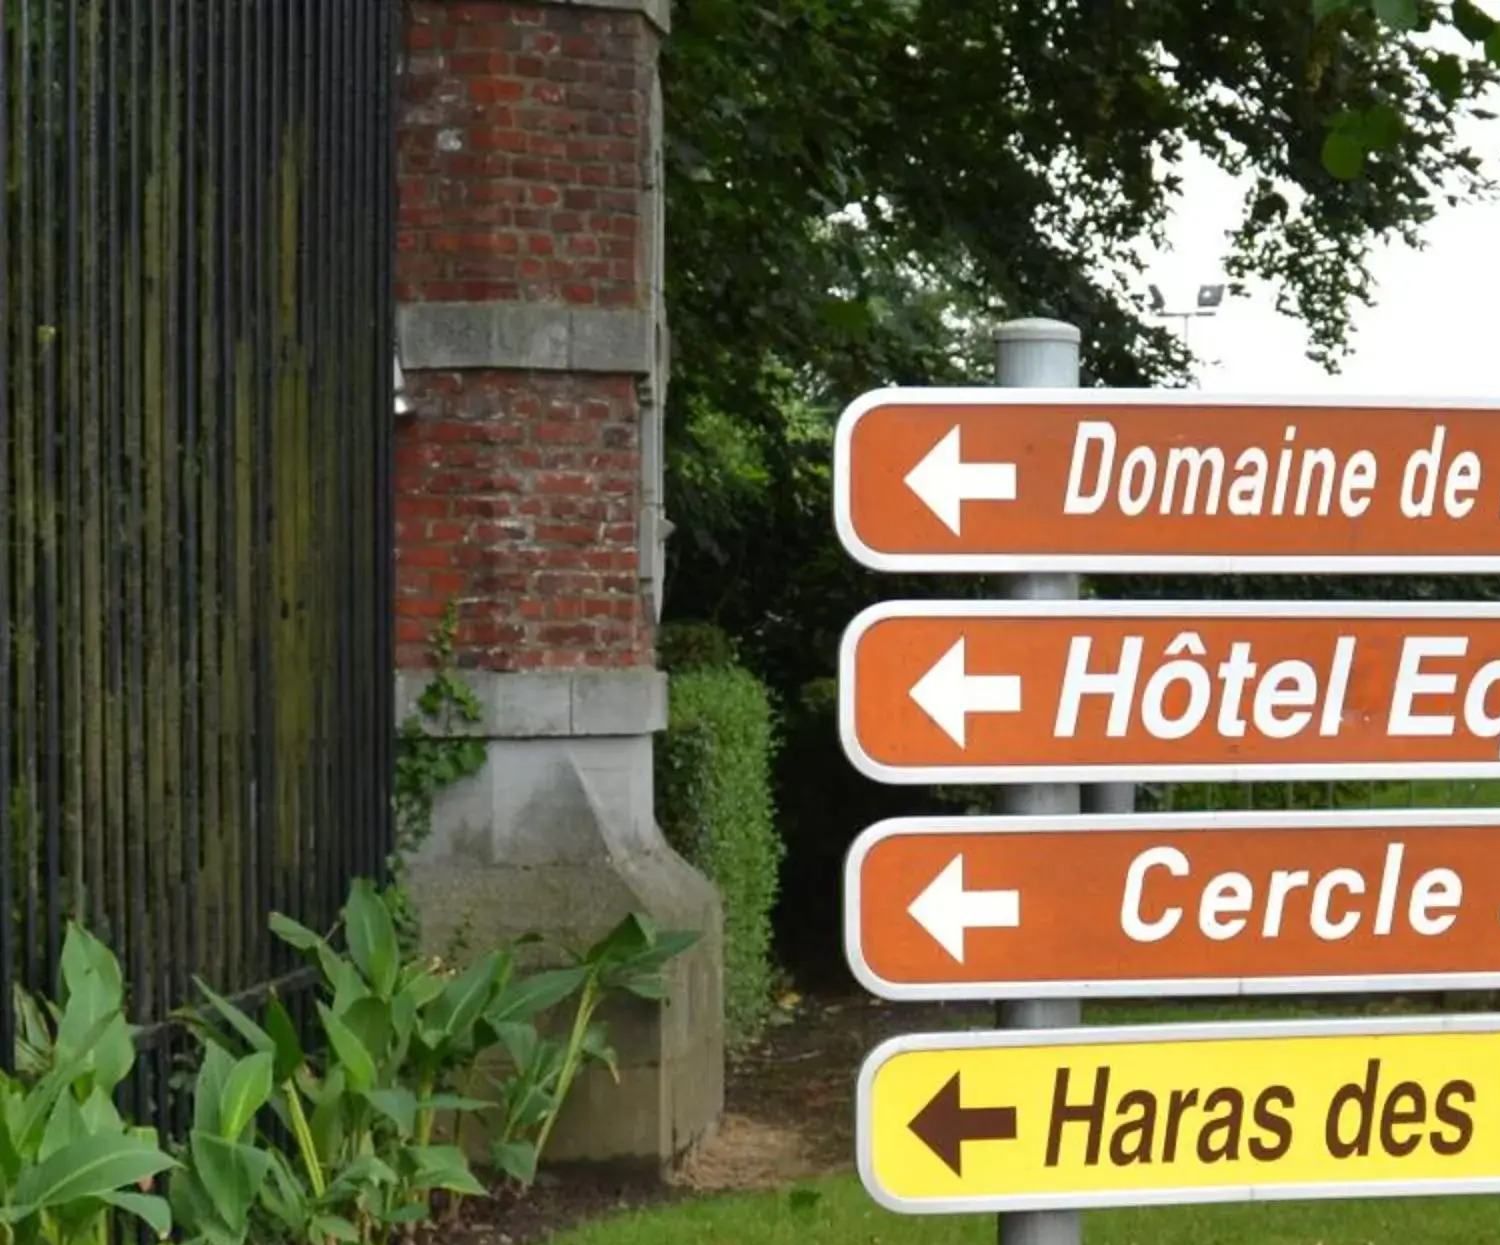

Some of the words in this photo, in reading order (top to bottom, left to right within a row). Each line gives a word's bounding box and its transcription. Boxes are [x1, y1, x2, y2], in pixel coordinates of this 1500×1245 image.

[1063, 420, 1378, 518] Domaine
[1400, 424, 1482, 519] de
[1053, 631, 1357, 740] Hôtel
[1120, 841, 1464, 943] Cercle
[1044, 1064, 1296, 1168] Haras
[1325, 1057, 1476, 1160] des
